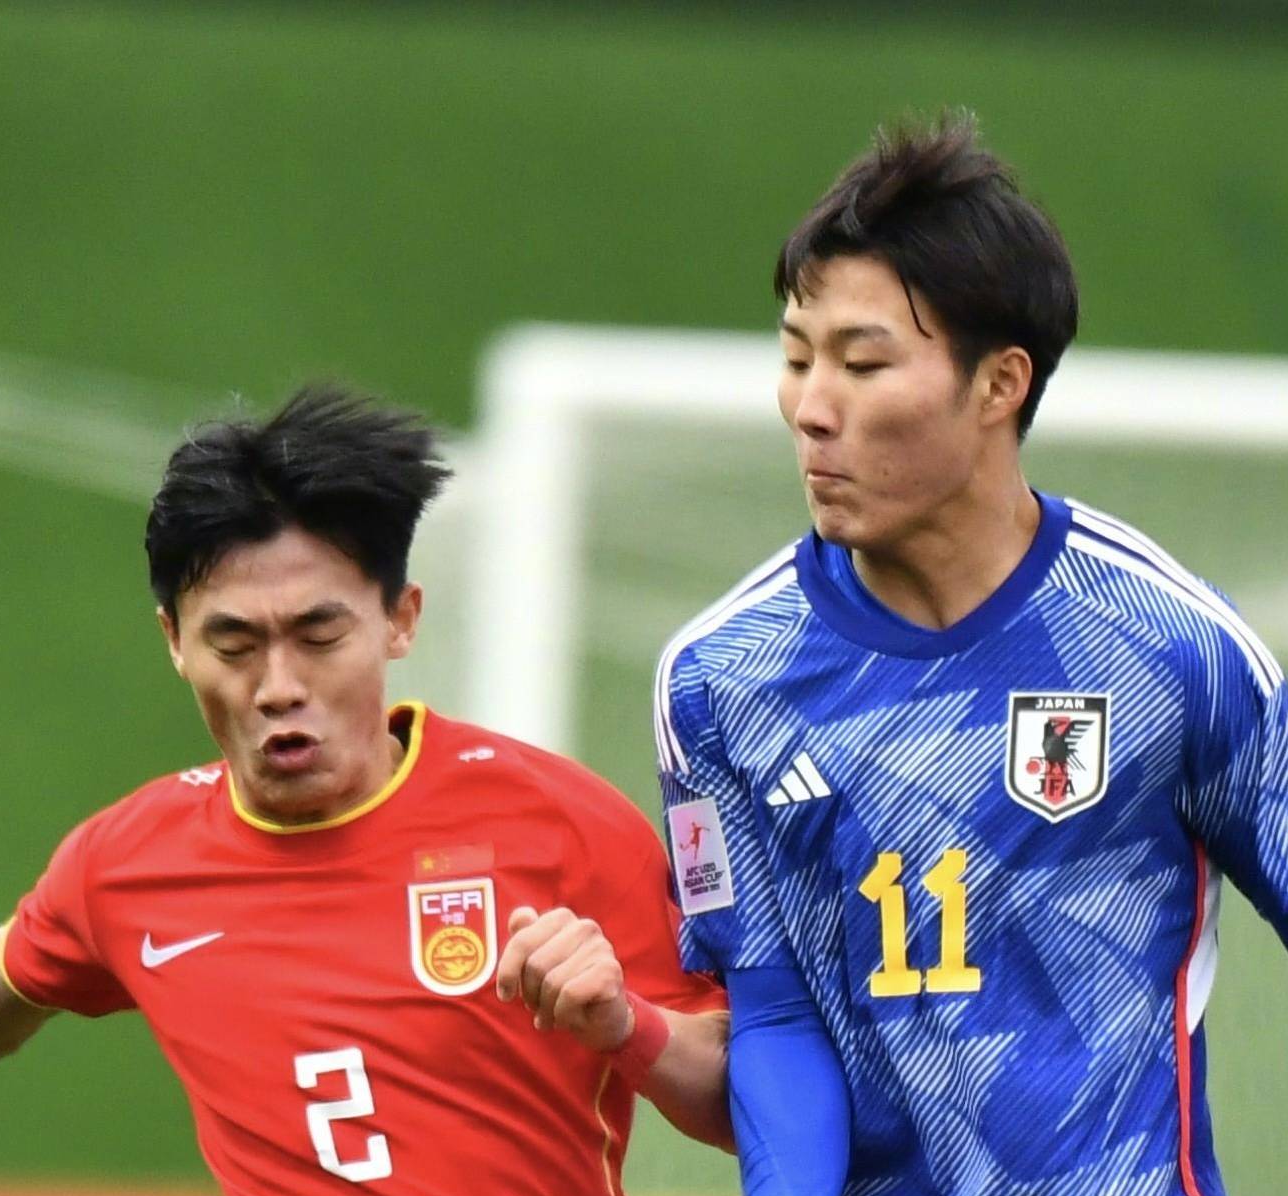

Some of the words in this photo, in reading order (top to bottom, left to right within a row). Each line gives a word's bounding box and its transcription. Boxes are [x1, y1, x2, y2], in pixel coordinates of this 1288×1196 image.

[1034, 697, 1085, 710] JAPAN
[1033, 777, 1076, 797] JFA
[421, 889, 484, 915] CFA
[859, 848, 982, 998] 11
[294, 1047, 393, 1183] 2
